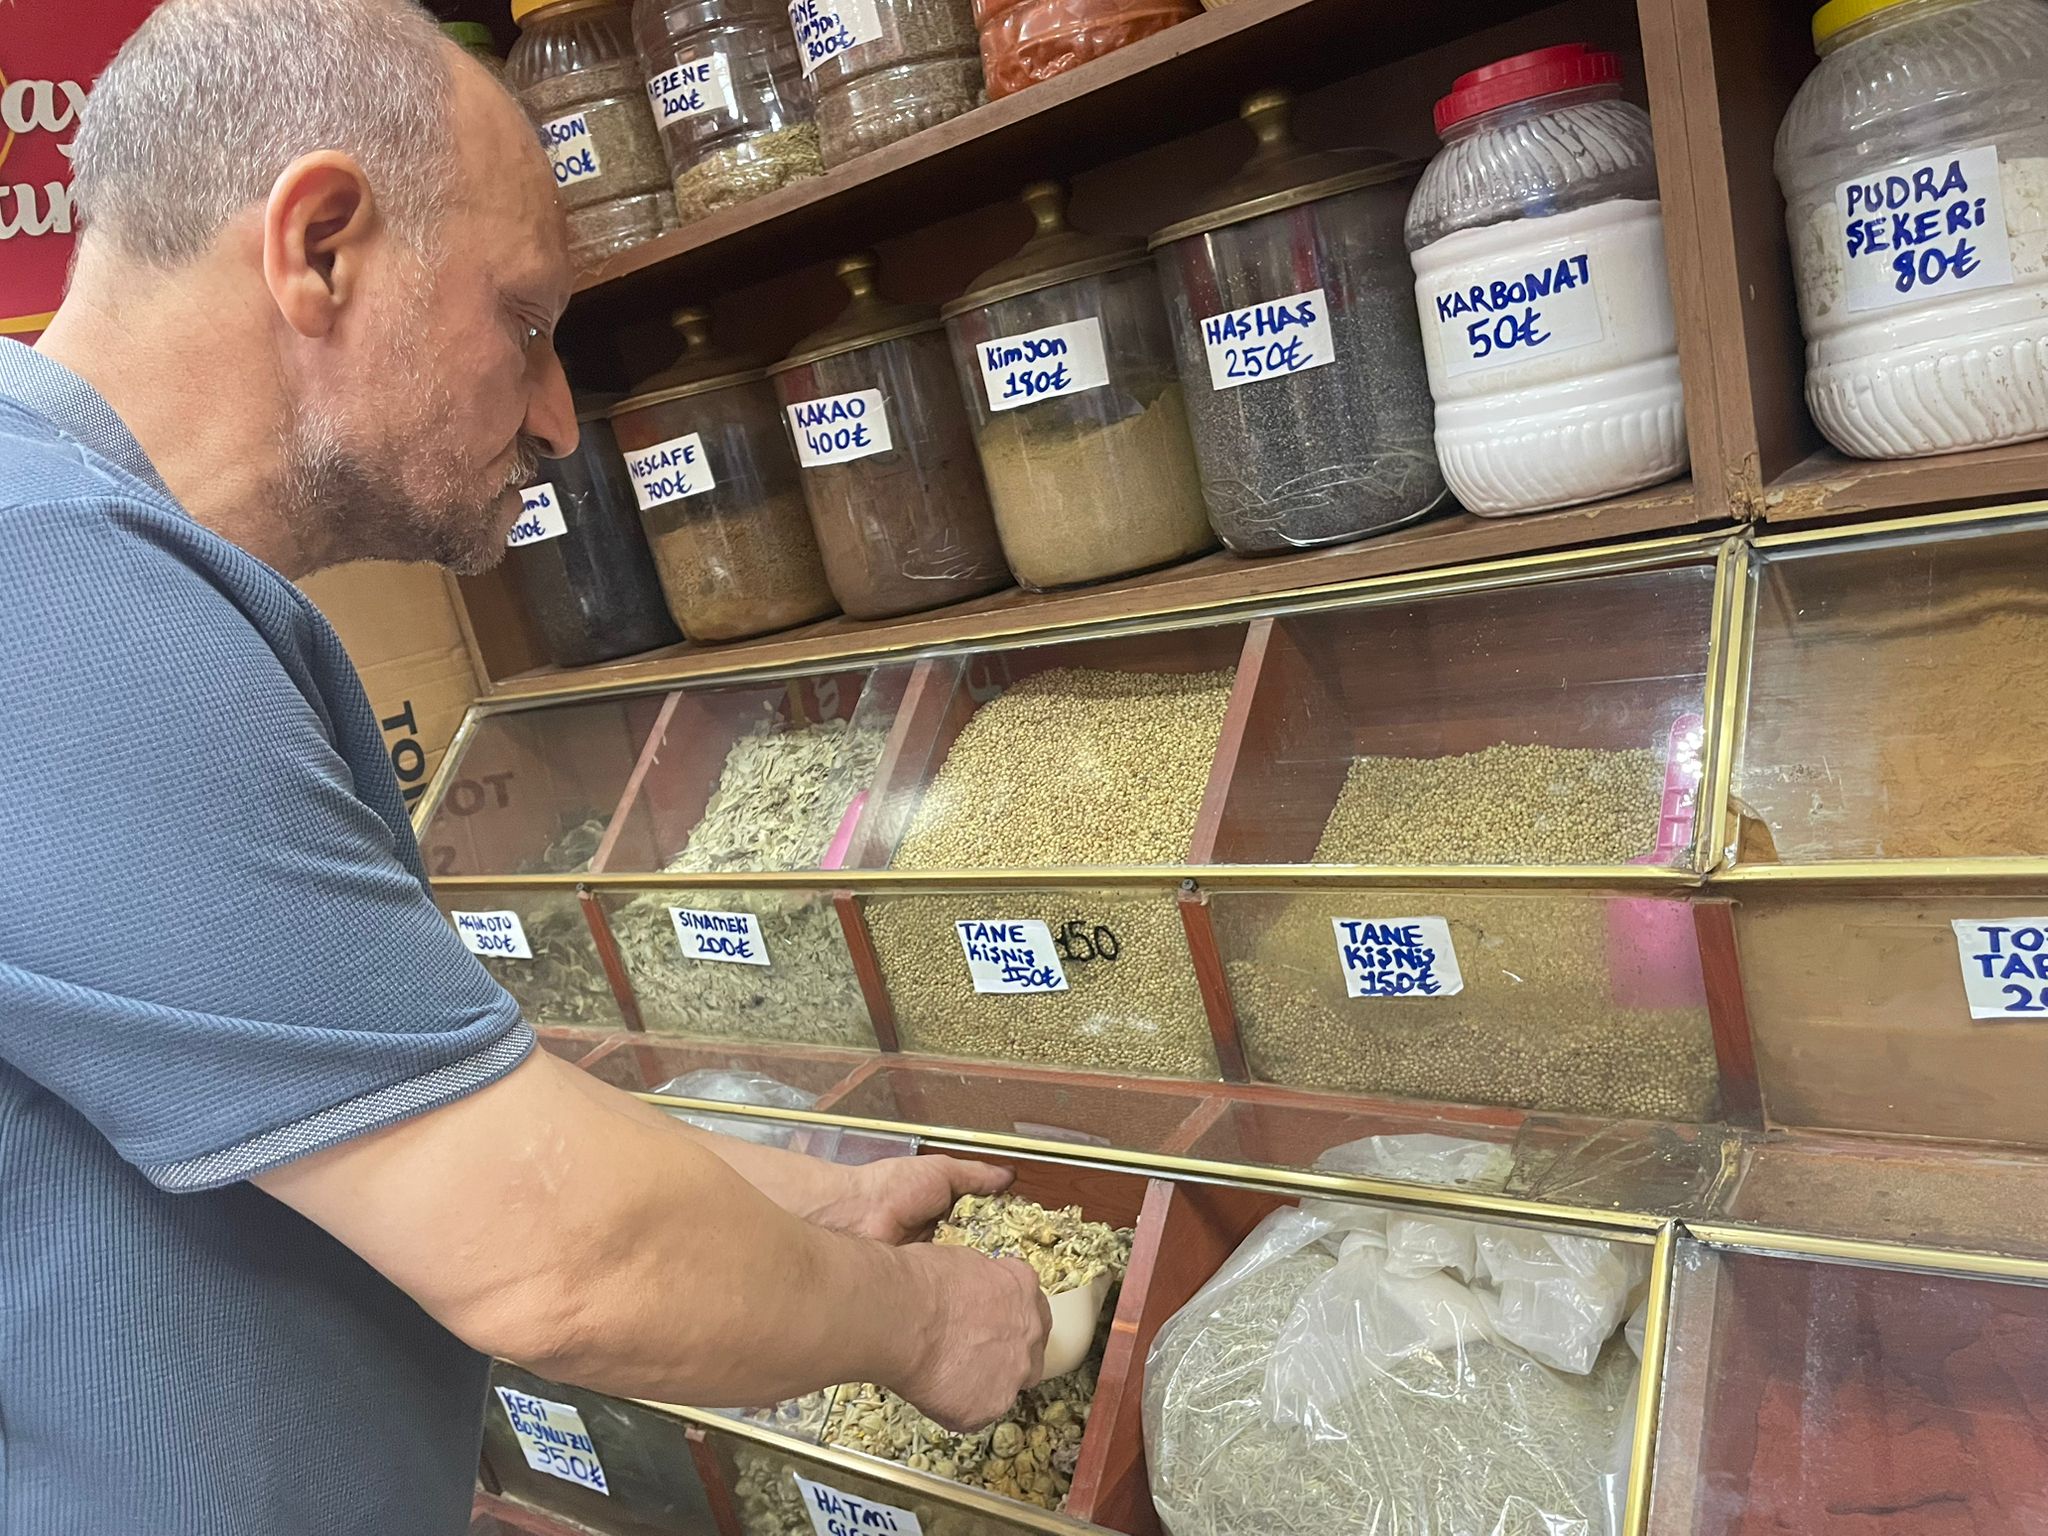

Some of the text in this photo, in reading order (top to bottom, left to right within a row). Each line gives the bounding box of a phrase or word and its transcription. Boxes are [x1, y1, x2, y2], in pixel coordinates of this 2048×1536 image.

[807, 24, 856, 62] 300₺
[662, 88, 705, 118] 200₺
[551, 119, 585, 145] SON
[553, 148, 596, 183] 00₺
[1846, 160, 1968, 218] PUDRA
[1892, 237, 1982, 293] 80₺
[1436, 254, 1590, 323] KARBONAT
[1466, 306, 1552, 358] 50₺
[1224, 334, 1314, 378] 250₺
[1002, 361, 1073, 399] 180₺
[794, 398, 866, 428] KAKAO
[805, 422, 873, 456] 400₺
[629, 444, 697, 480] NESCAFE
[643, 469, 694, 502] 700₺
[475, 933, 517, 954] 300₺
[695, 933, 755, 959] 200₺
[958, 922, 1028, 944] TANE
[1339, 922, 1424, 948] TANE
[1976, 926, 2048, 952] TO
[511, 1413, 594, 1456] BOYNUZU
[532, 1440, 605, 1488] 350₺
